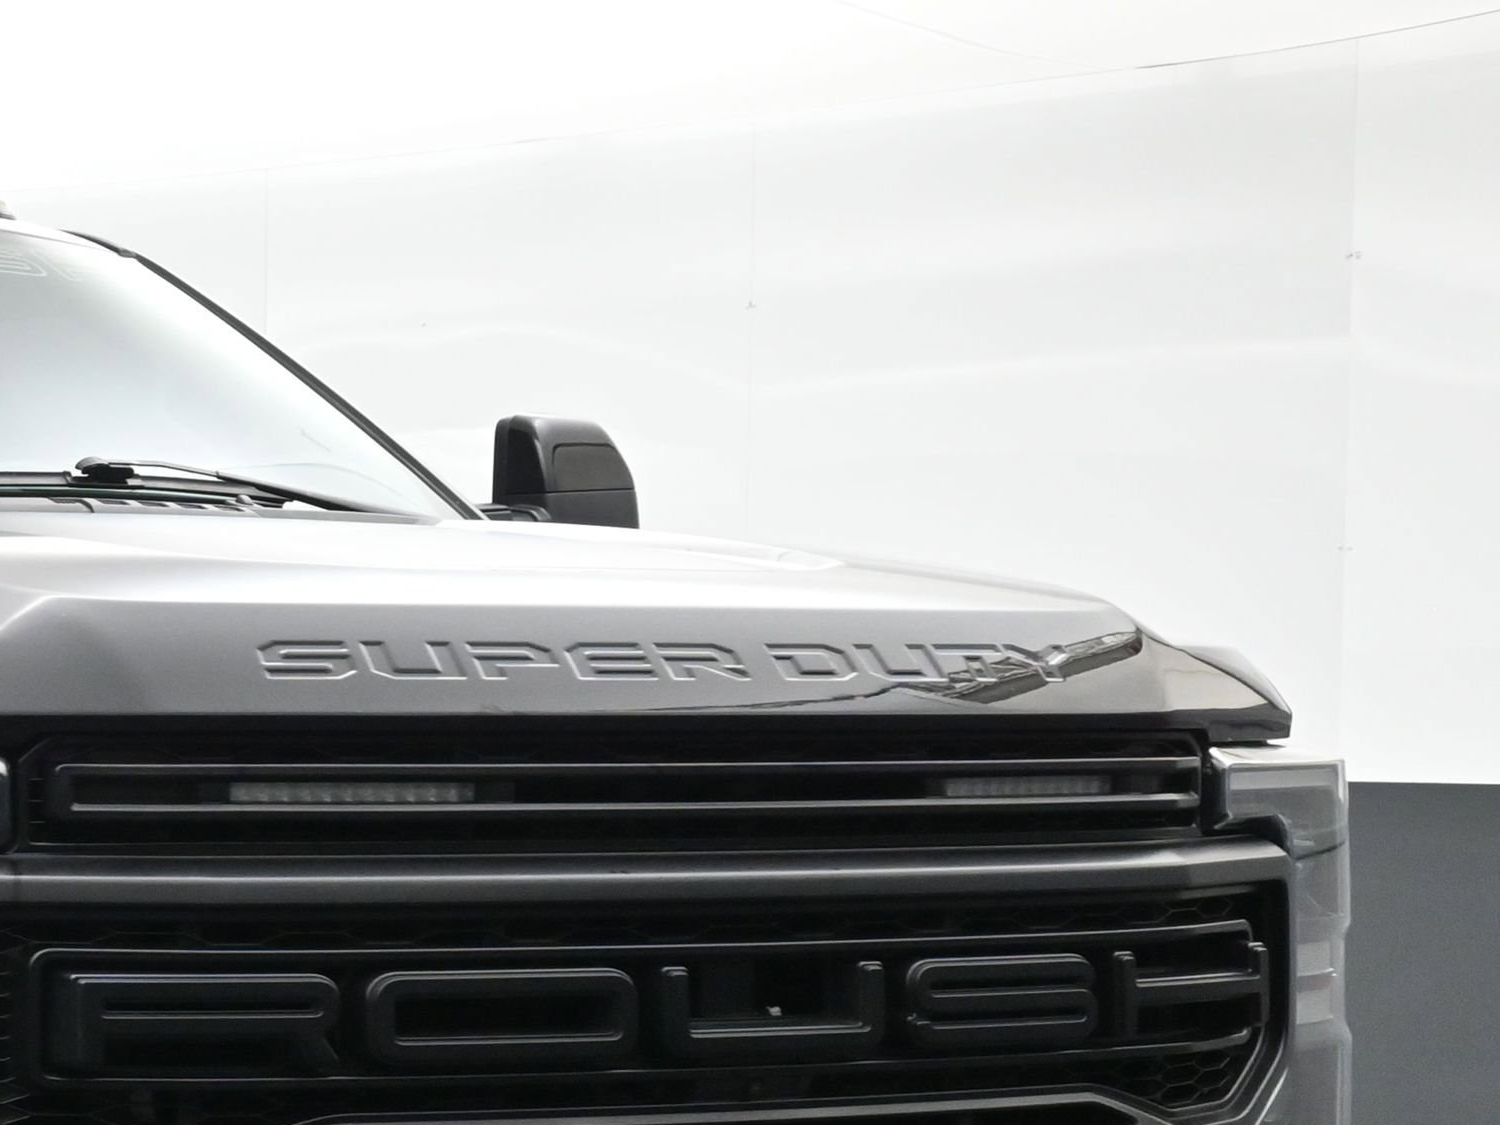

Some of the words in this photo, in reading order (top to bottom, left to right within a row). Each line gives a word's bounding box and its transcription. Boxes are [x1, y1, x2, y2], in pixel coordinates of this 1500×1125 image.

[255, 639, 752, 682] SUPER
[762, 639, 1069, 684] DUTY
[58, 941, 1270, 1079] ROUSH
